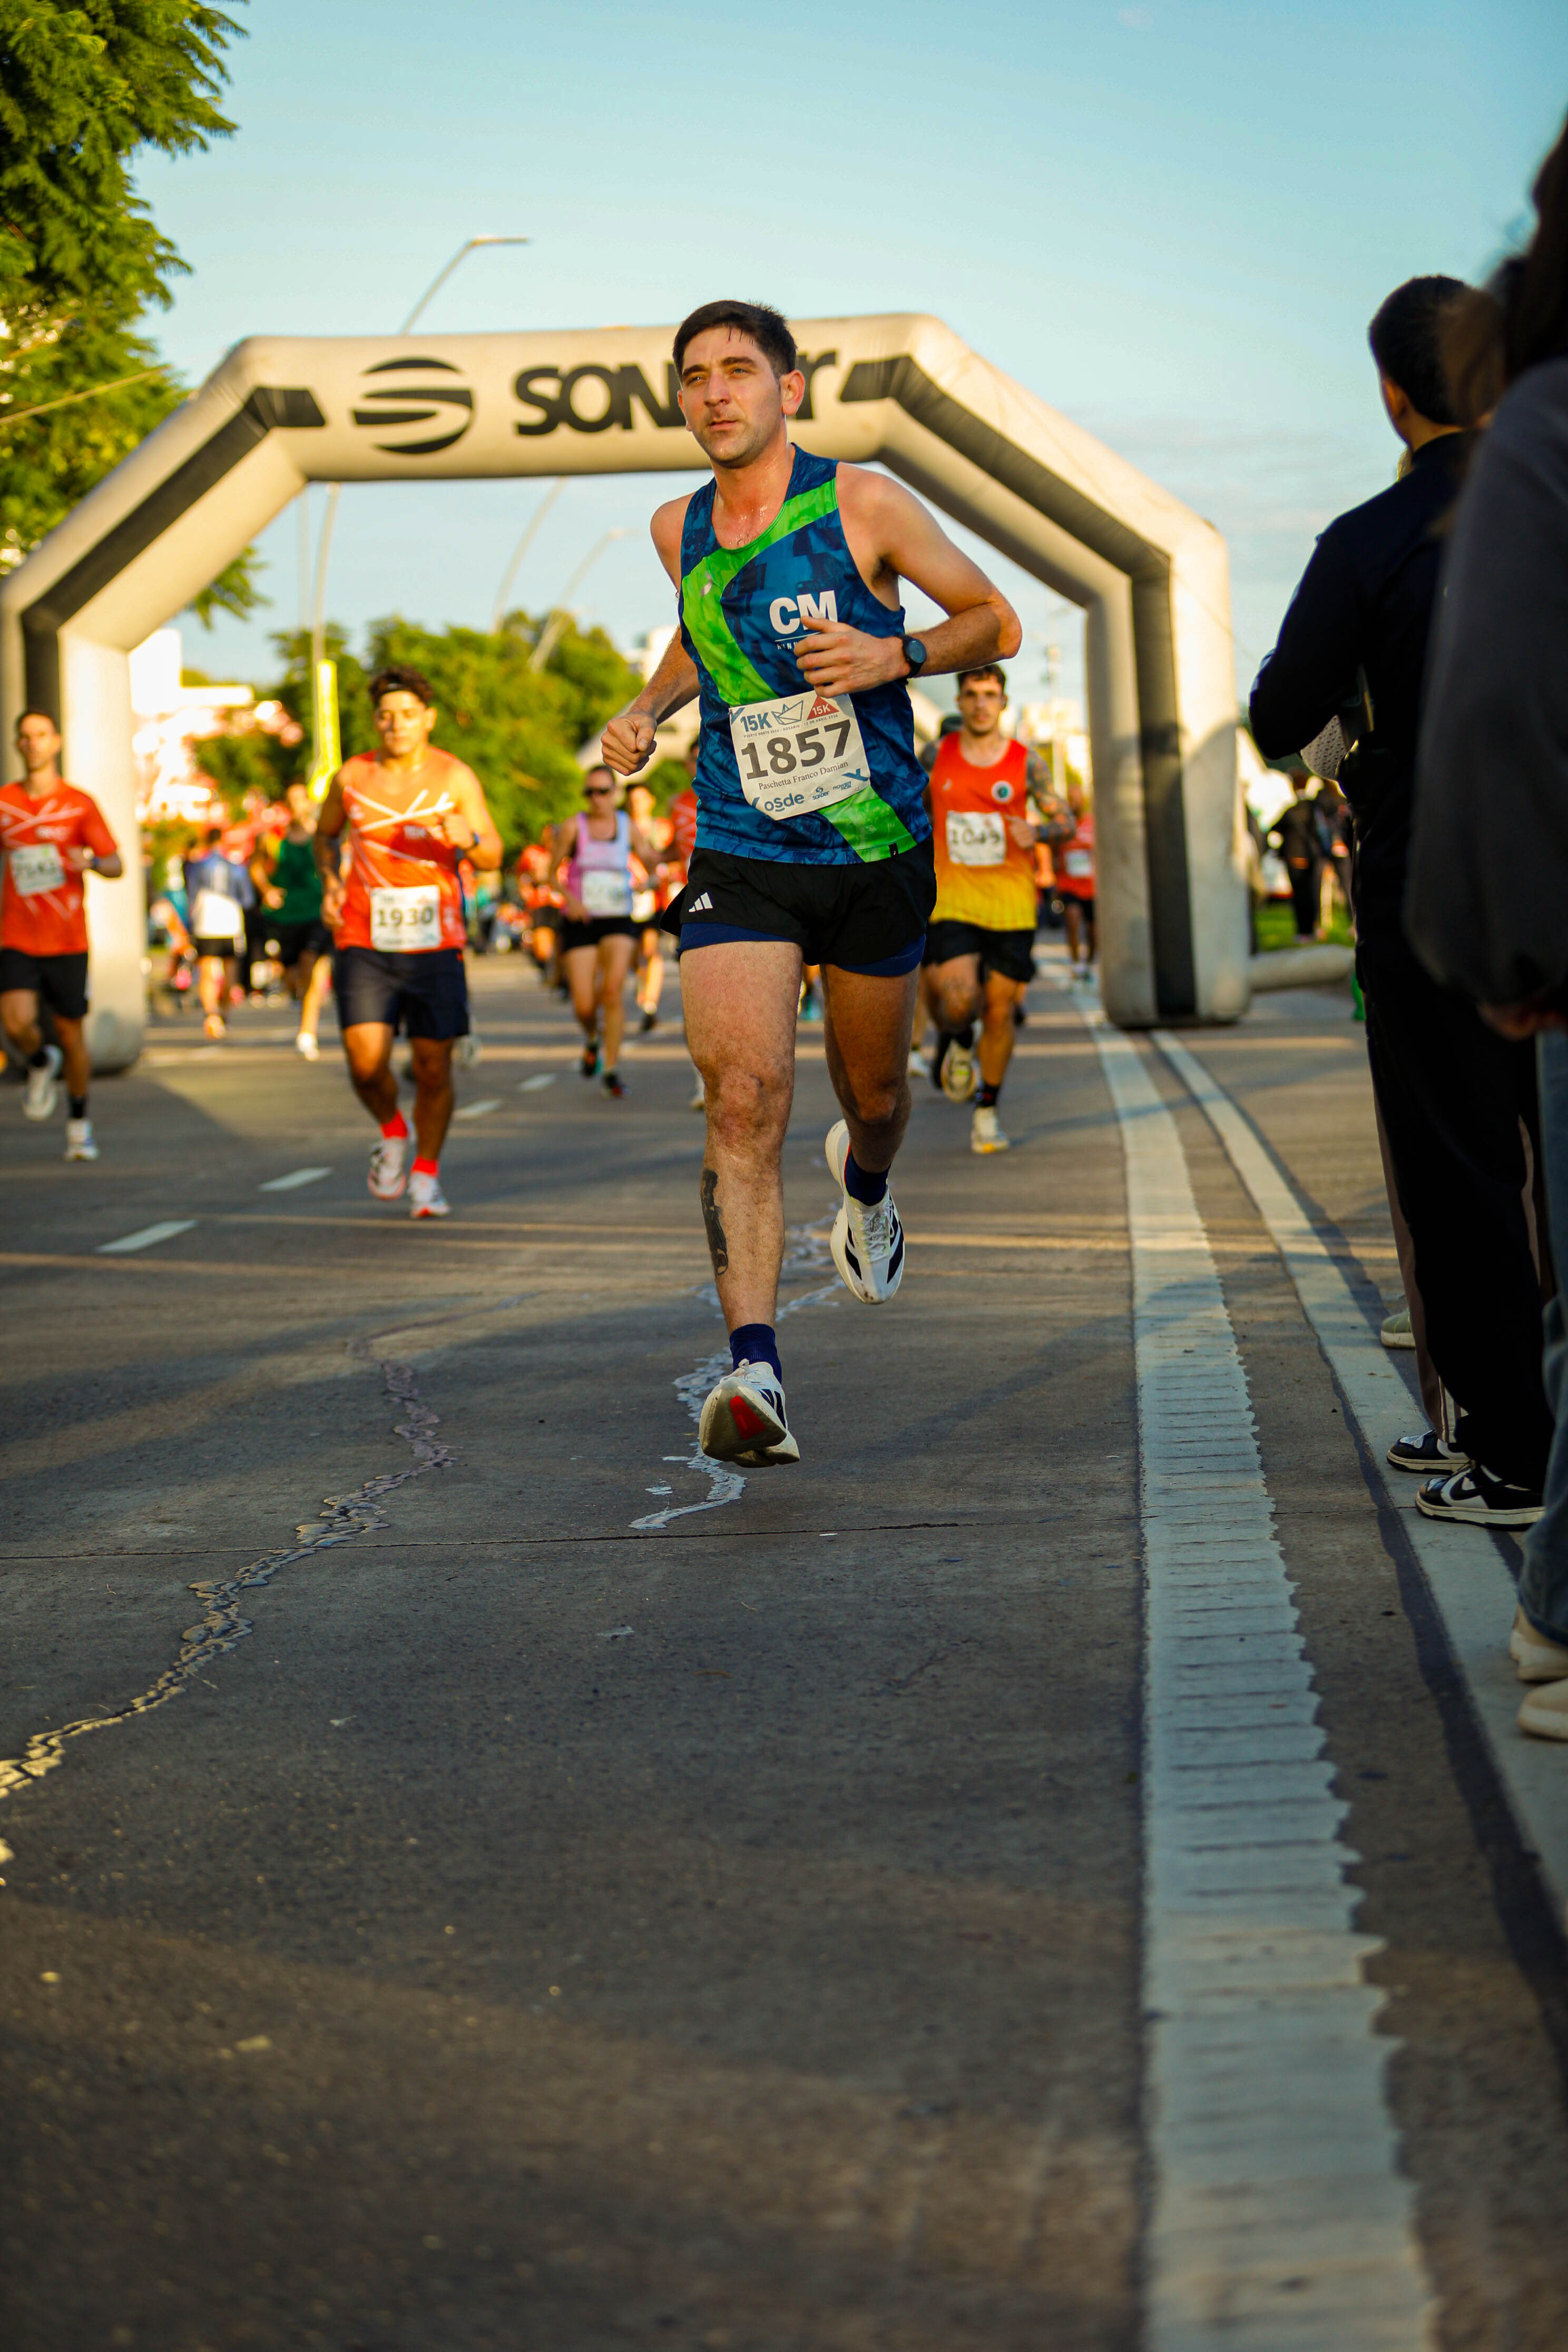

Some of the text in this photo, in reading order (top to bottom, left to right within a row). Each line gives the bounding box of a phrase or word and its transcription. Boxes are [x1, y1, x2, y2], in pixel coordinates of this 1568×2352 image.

[514, 351, 837, 436] SONr
[770, 590, 838, 634] CM
[812, 703, 831, 716] 15K
[740, 712, 772, 732] 15K
[741, 719, 851, 780] 1857
[759, 762, 849, 790] Paschetta Franco Damian
[765, 792, 805, 812] osde
[378, 906, 434, 927] 1930
